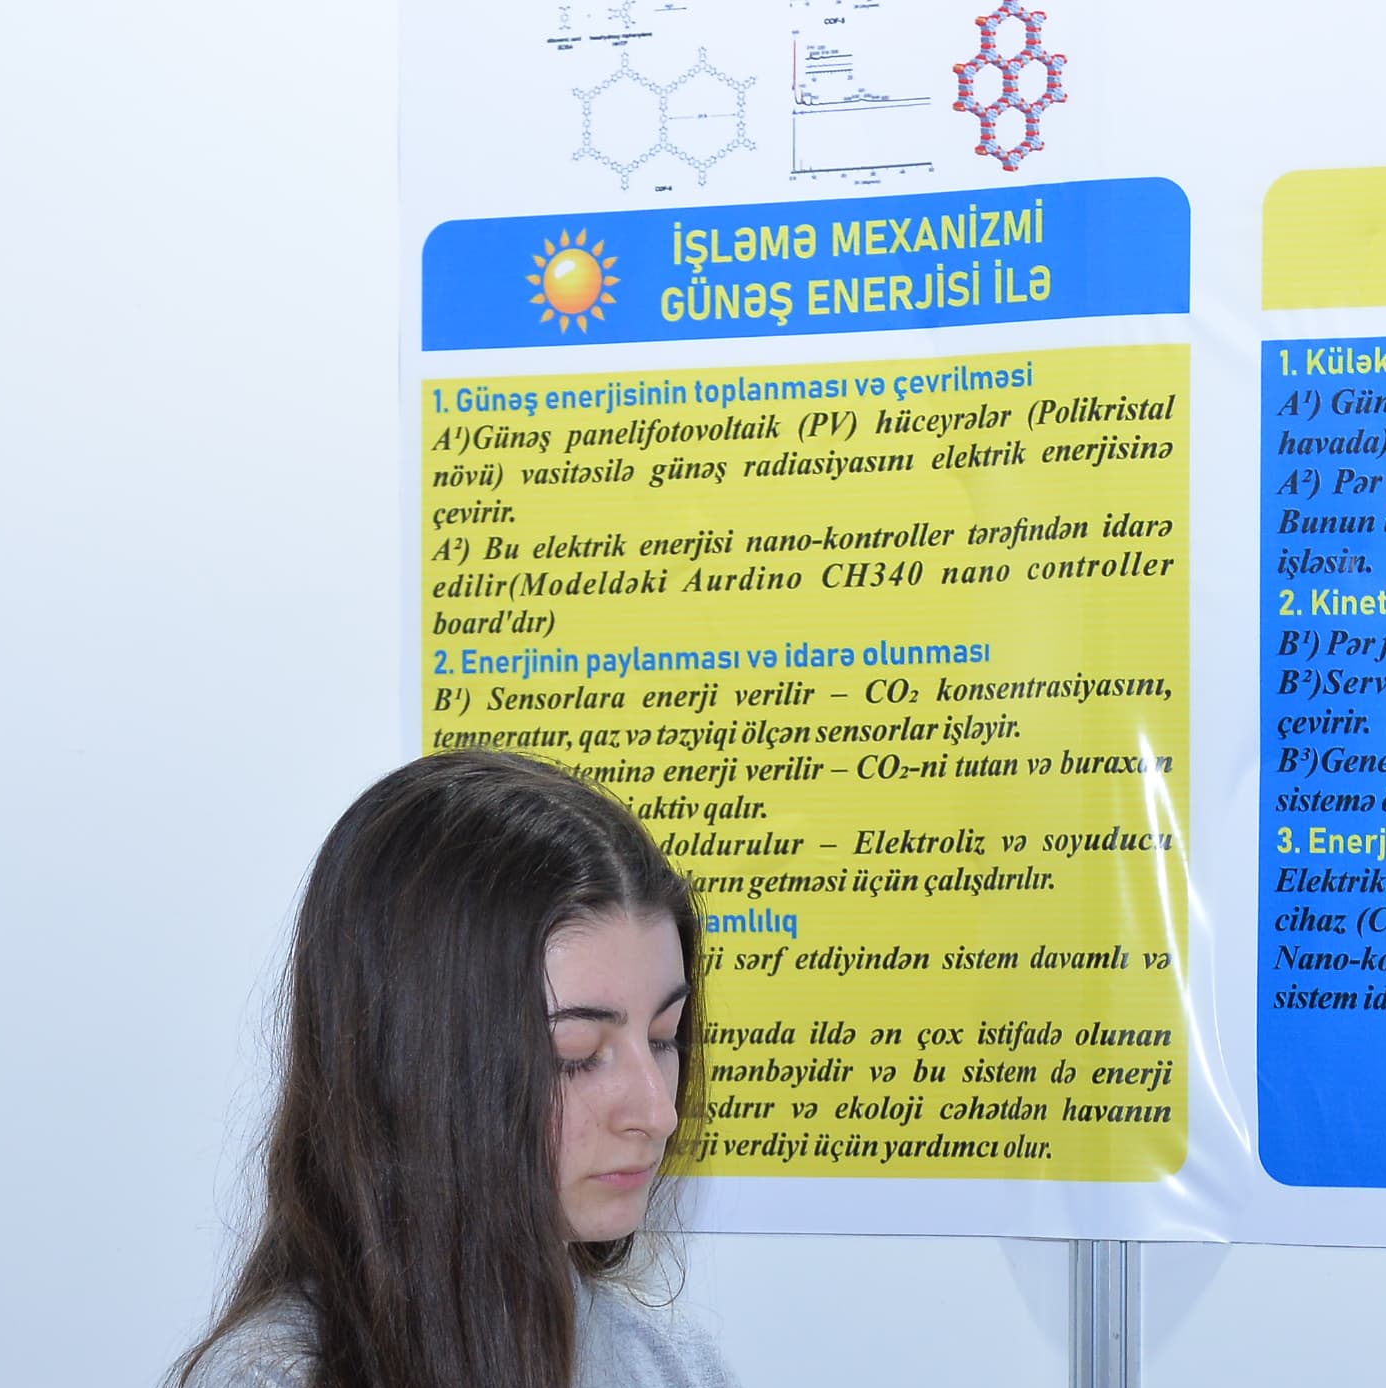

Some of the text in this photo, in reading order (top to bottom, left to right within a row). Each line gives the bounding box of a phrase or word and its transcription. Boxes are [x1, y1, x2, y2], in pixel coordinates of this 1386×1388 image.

[674, 198, 1043, 272] İŞLƏMƏ MEXANİZMİ
[662, 259, 1051, 325] GÜNƏŞ ENERJİSİ İLƏ
[1280, 349, 1297, 376] 1.
[434, 361, 1033, 417] 1. Günəş enerjisinin toplanması və çevrilməsi
[565, 414, 780, 454] panelifotovoltaik
[799, 411, 856, 444] (PV)
[876, 403, 1011, 438] hüceyrələr
[1028, 394, 1175, 431] (Polikristal
[433, 440, 1173, 492] növü) vasitəsilə günəş radiasiyasını elektrik enerjisinə
[433, 499, 514, 531] çevirir.
[1280, 588, 1302, 616] 2.
[435, 639, 990, 680] 2. Enerjinin paylanması və idarə olunması
[487, 685, 624, 711] Sensorlara
[643, 682, 718, 714] enerji
[736, 681, 815, 706] verilir
[937, 677, 1171, 704] konsentrasiyasını,
[1278, 827, 1301, 854] 3.
[1276, 868, 1385, 893] Elektrik
[704, 909, 797, 939] amlılıq
